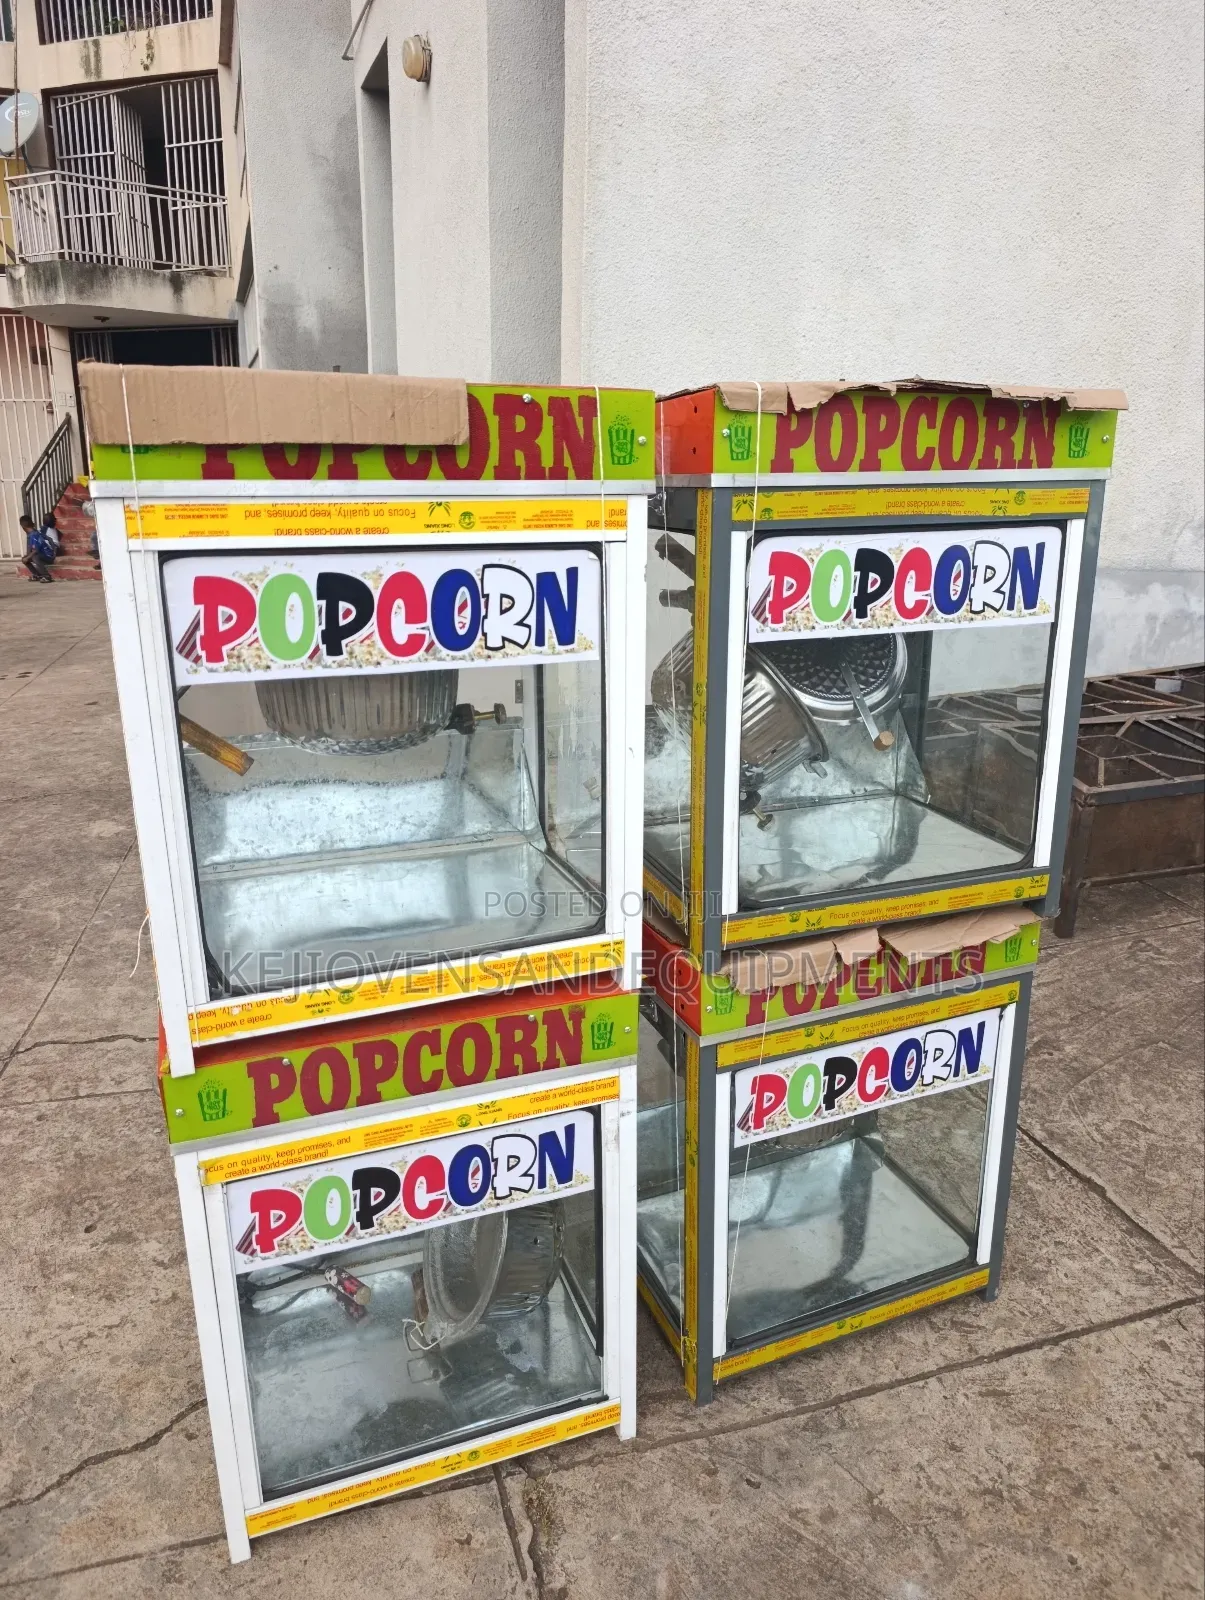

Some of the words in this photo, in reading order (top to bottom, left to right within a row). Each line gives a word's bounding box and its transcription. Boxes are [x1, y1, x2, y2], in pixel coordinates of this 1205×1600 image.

[769, 393, 1062, 475] POPCORN
[245, 509, 262, 520] and
[264, 508, 308, 519] promises,
[310, 508, 332, 519] keep
[335, 508, 370, 519] quality,
[374, 508, 384, 517] on
[388, 508, 416, 519] Focus
[768, 540, 1046, 624] POPCORN
[193, 563, 580, 665] POPCORN
[247, 1013, 272, 1024] create
[247, 1005, 586, 1129] POPCORN
[753, 1020, 986, 1130] POPCORN
[529, 1095, 551, 1104] create
[558, 1085, 594, 1098] world-class
[595, 1080, 617, 1092] brand!
[507, 1111, 531, 1121] Focus
[224, 1168, 250, 1179] create
[258, 1156, 303, 1172] world-class
[304, 1149, 329, 1162] brand!
[227, 1161, 238, 1169] on
[241, 1153, 273, 1167] quality,
[276, 1150, 296, 1160] keep
[297, 1140, 335, 1156] promises,
[336, 1136, 351, 1146] and
[250, 1123, 576, 1254] POPCORN
